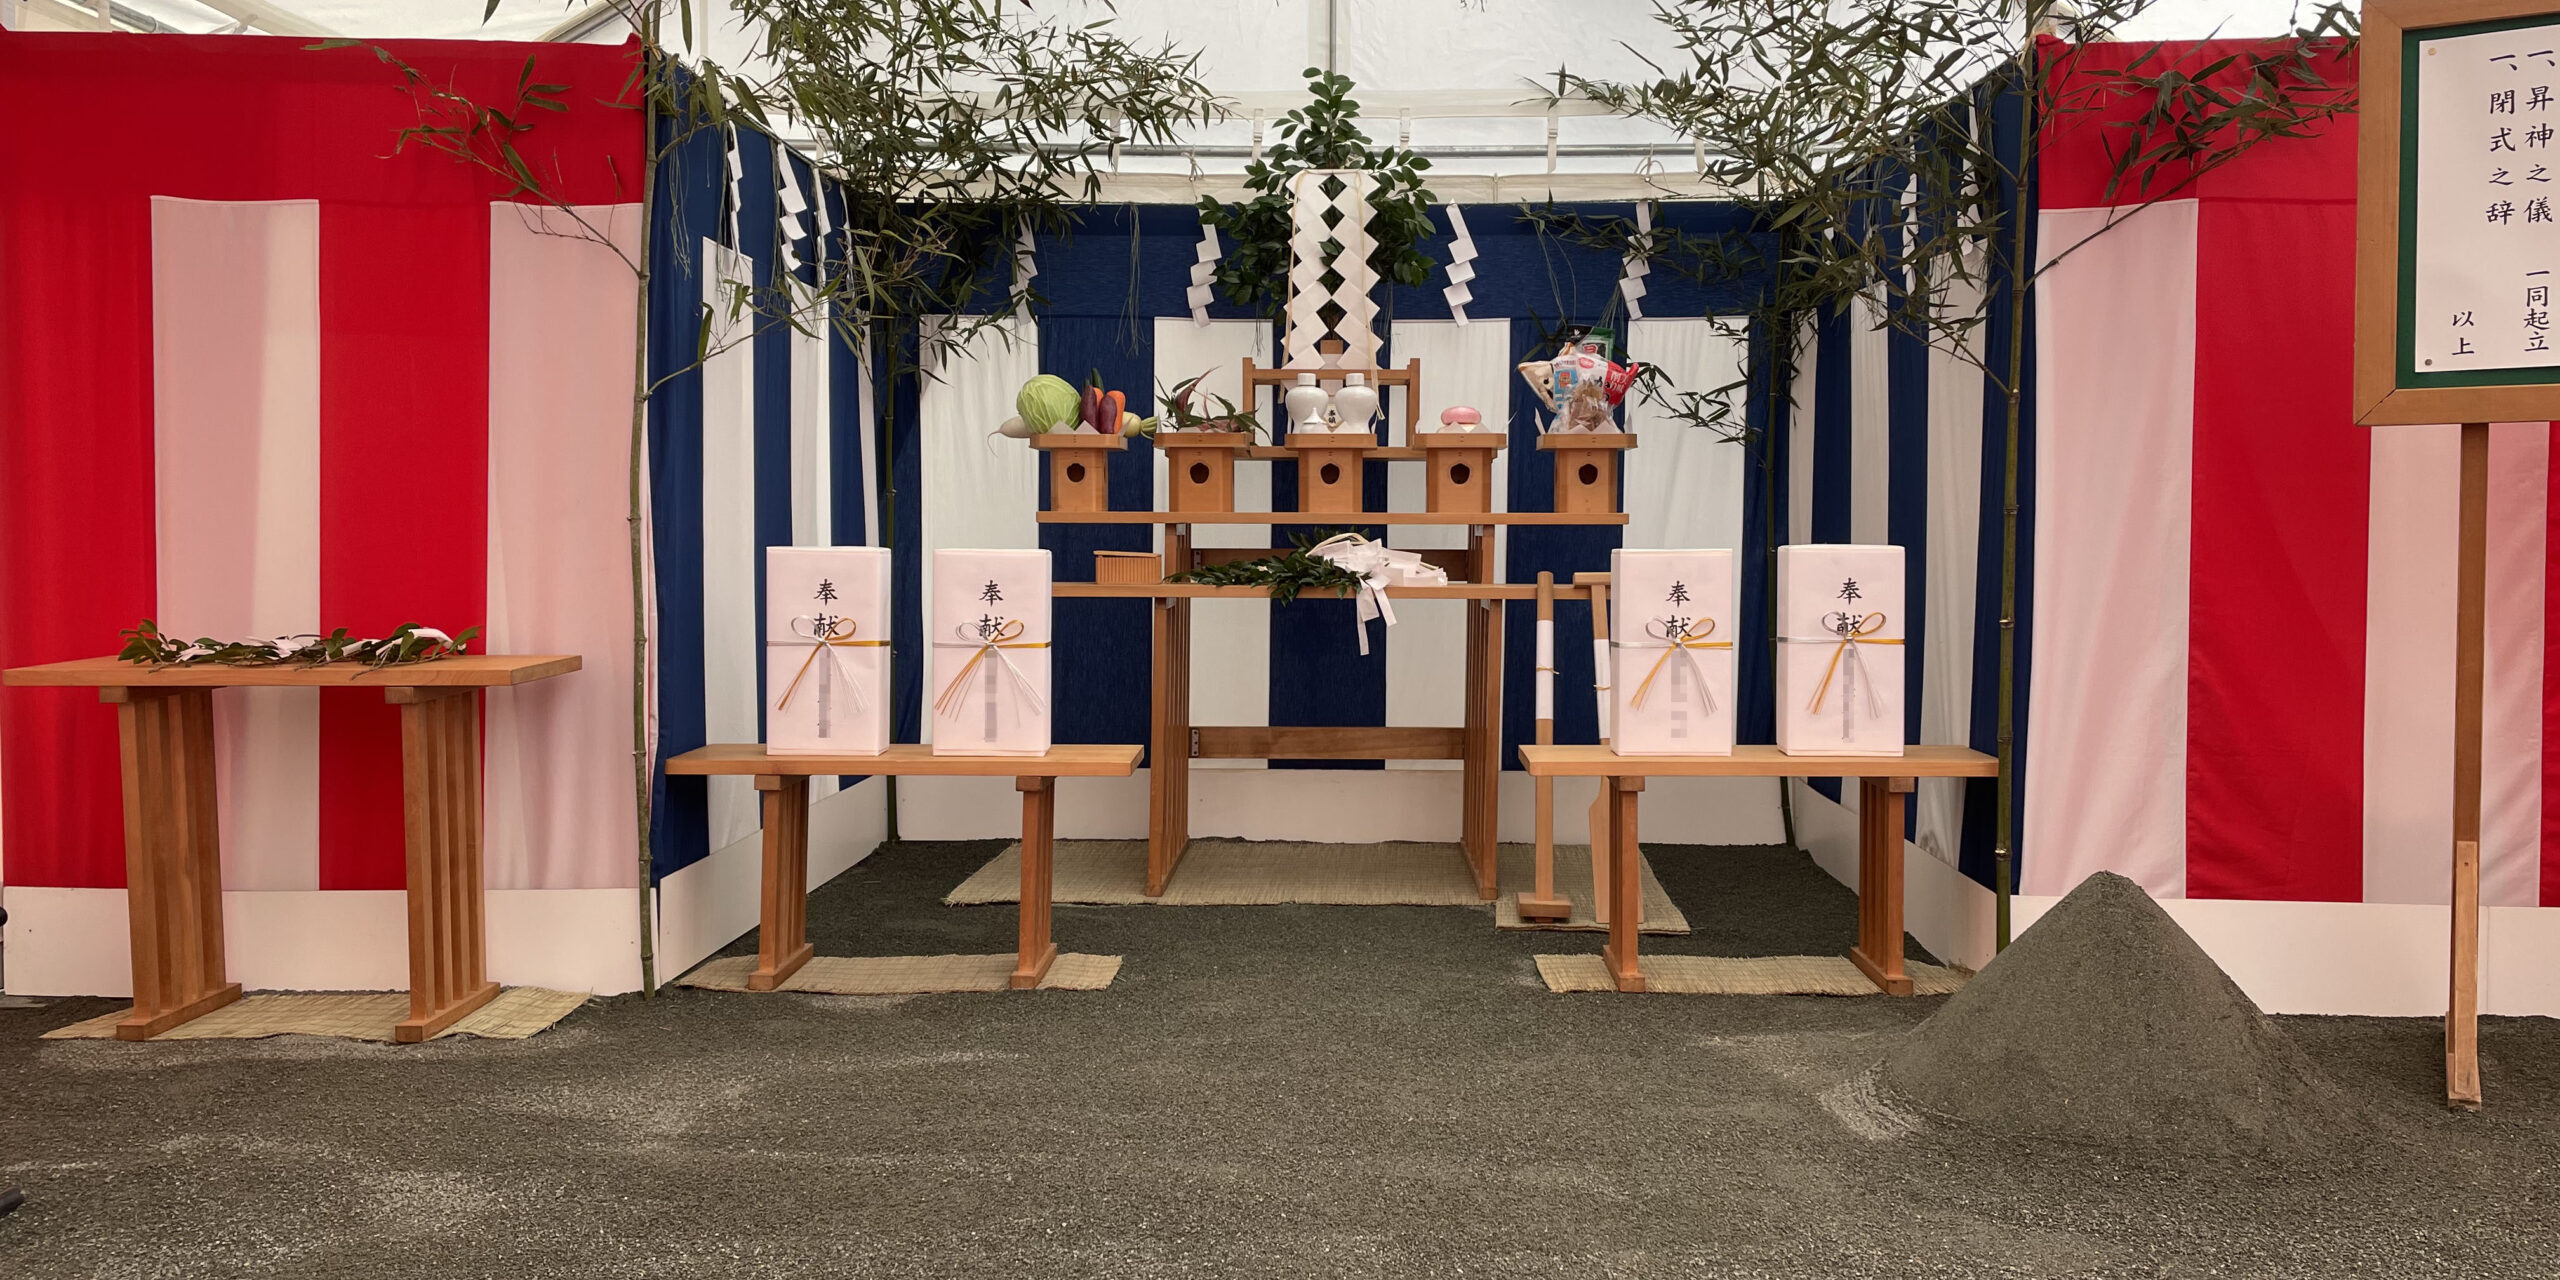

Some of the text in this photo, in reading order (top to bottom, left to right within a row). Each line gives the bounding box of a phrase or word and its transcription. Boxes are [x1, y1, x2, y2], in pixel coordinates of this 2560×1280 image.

[2451, 310, 2475, 356] 以上
[2523, 270, 2550, 352] 一同起立
[813, 578, 840, 637] 奉献
[978, 579, 1005, 637] 奉献
[1665, 580, 1692, 638] 奉献
[1836, 577, 1863, 635] 奉献
